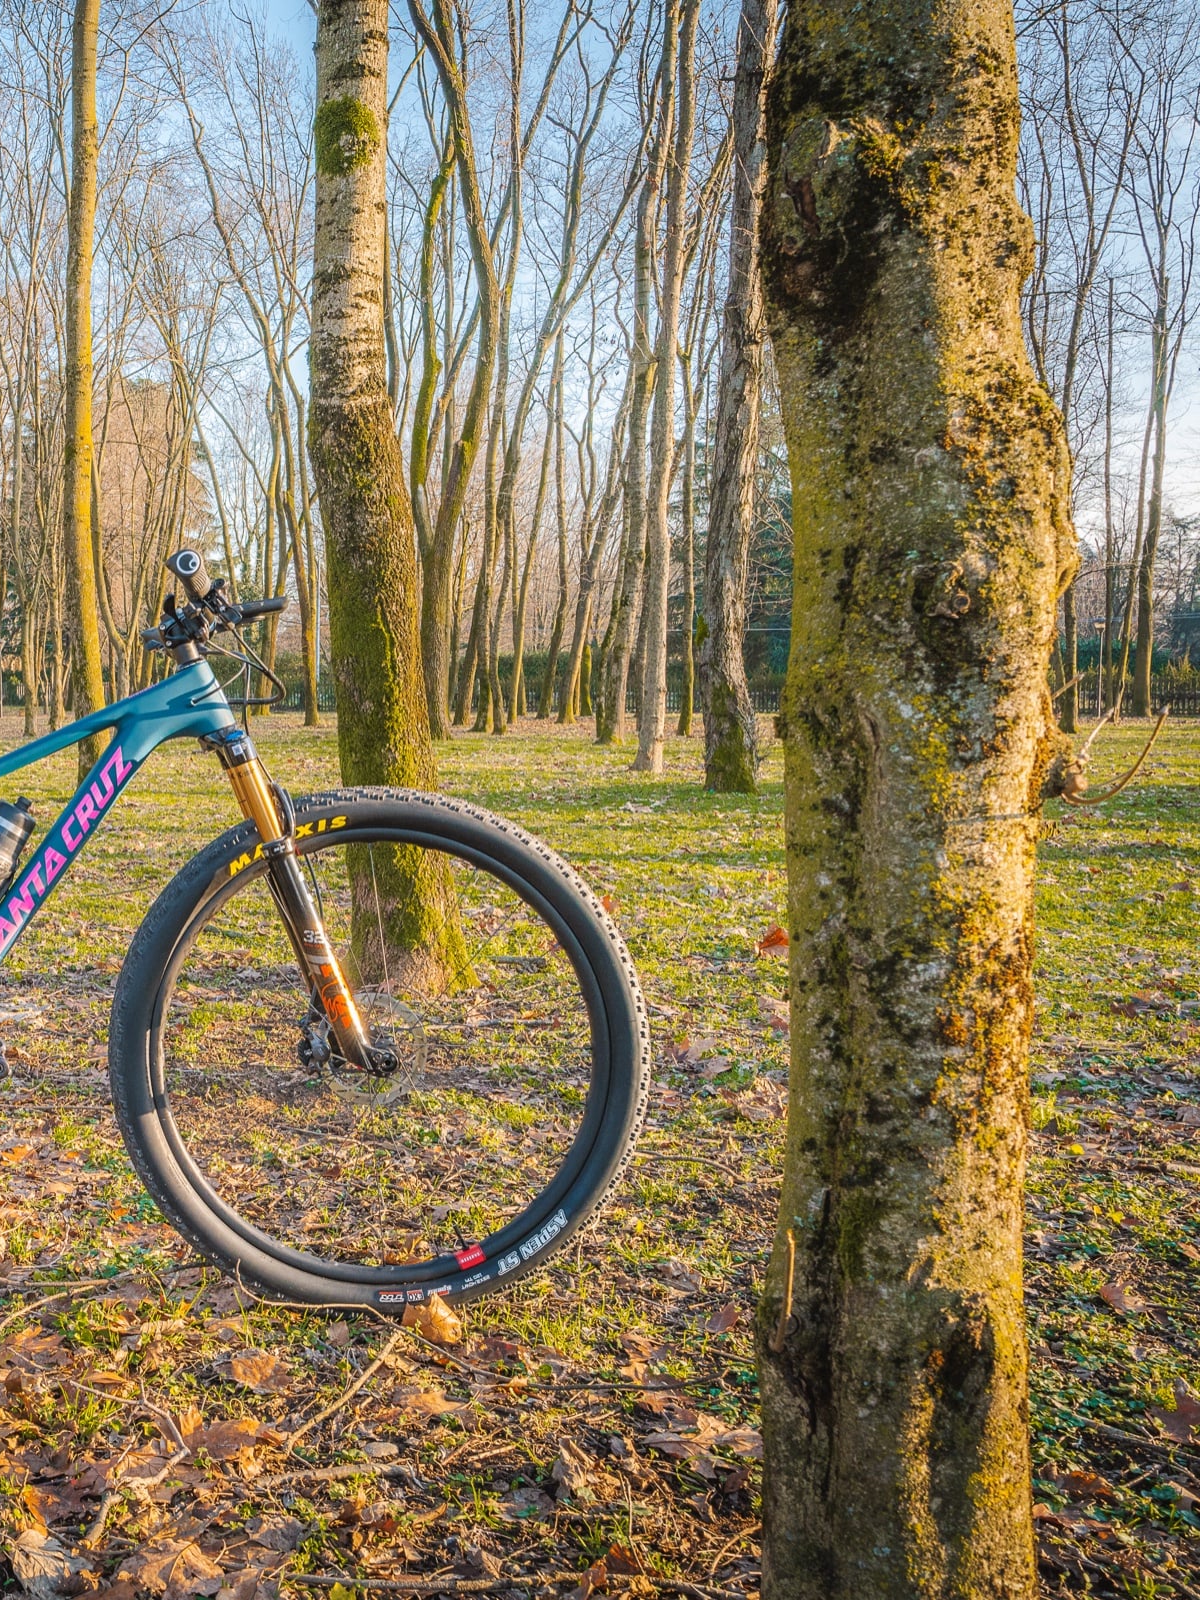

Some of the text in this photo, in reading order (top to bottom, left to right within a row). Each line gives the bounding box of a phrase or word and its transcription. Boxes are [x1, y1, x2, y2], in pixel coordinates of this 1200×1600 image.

[61, 745, 133, 853] CRUZ
[229, 815, 348, 877] MAXIS
[303, 929, 325, 944] 32
[497, 1208, 569, 1276] ASPEN ST
